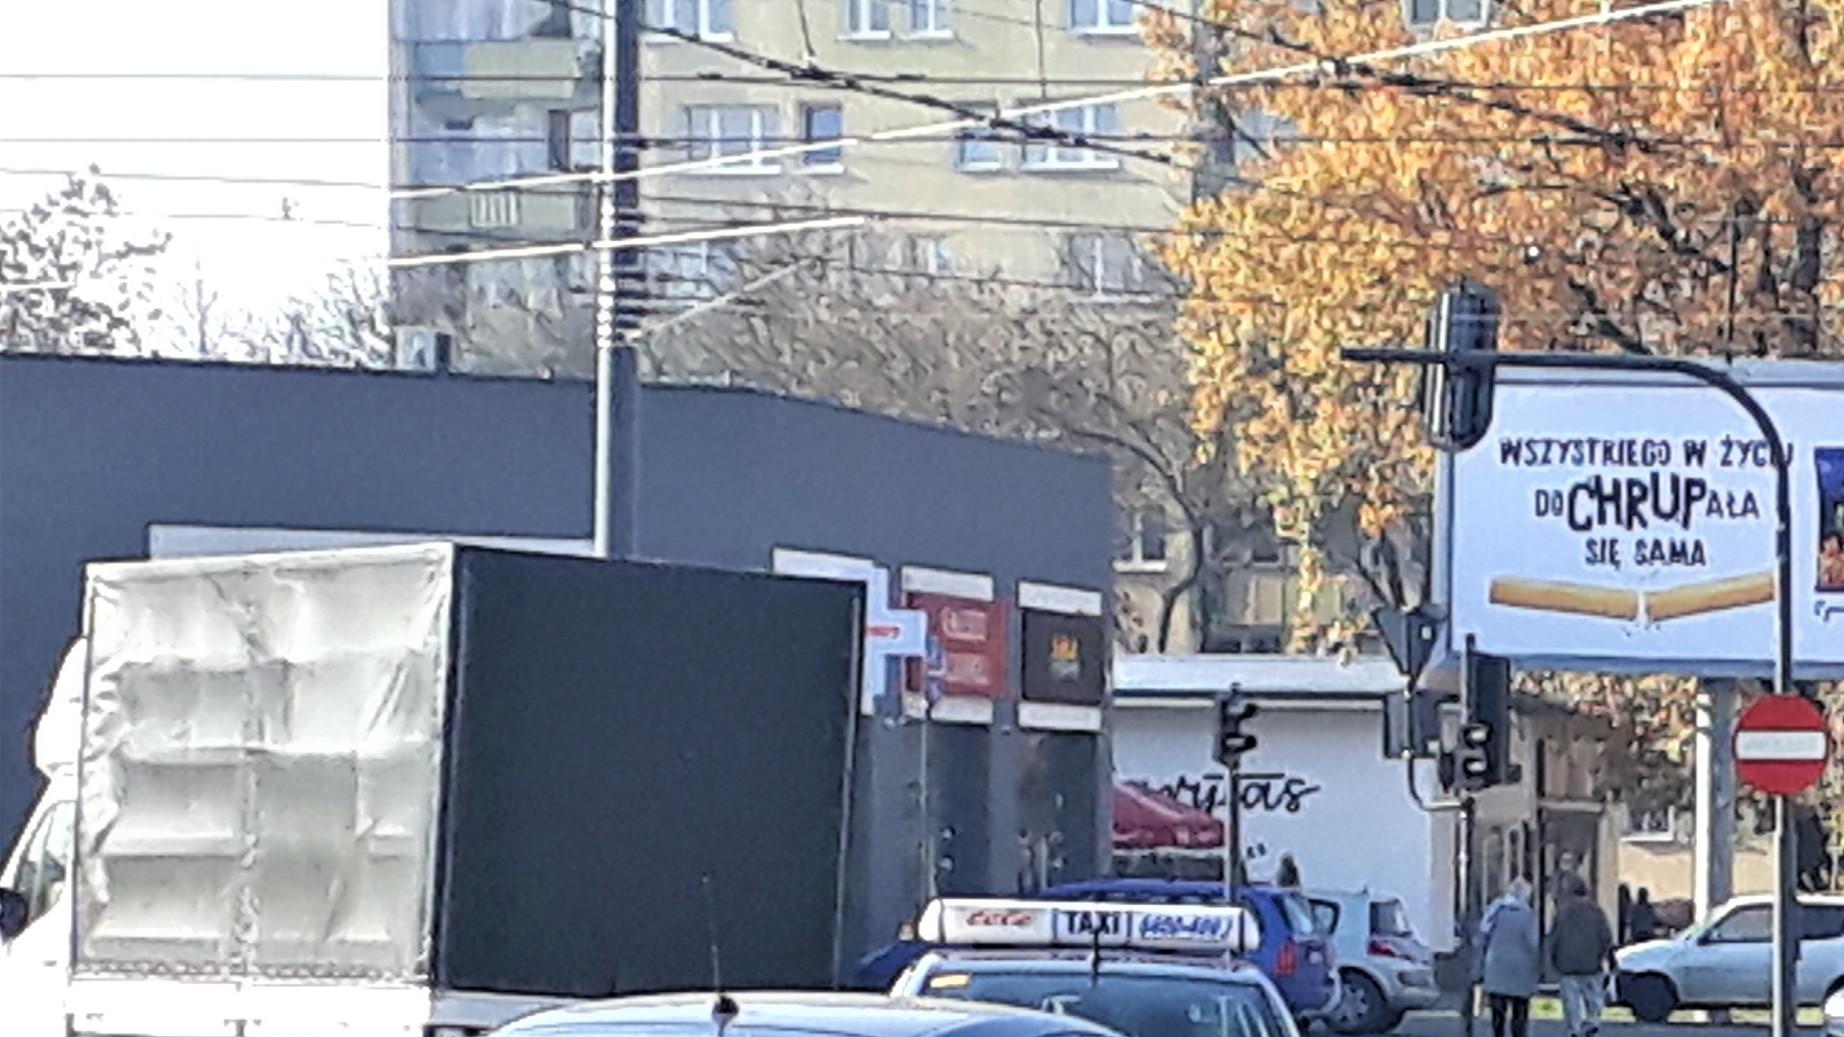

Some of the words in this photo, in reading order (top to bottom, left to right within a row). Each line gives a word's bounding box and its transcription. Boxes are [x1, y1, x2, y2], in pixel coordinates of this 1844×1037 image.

[1499, 437, 1671, 467] WSZYSTKIEGO
[1682, 439, 1706, 467] W
[1585, 538, 1620, 570] SIĘ
[1634, 538, 1706, 567] SAMA
[1066, 910, 1121, 935] TAXI
